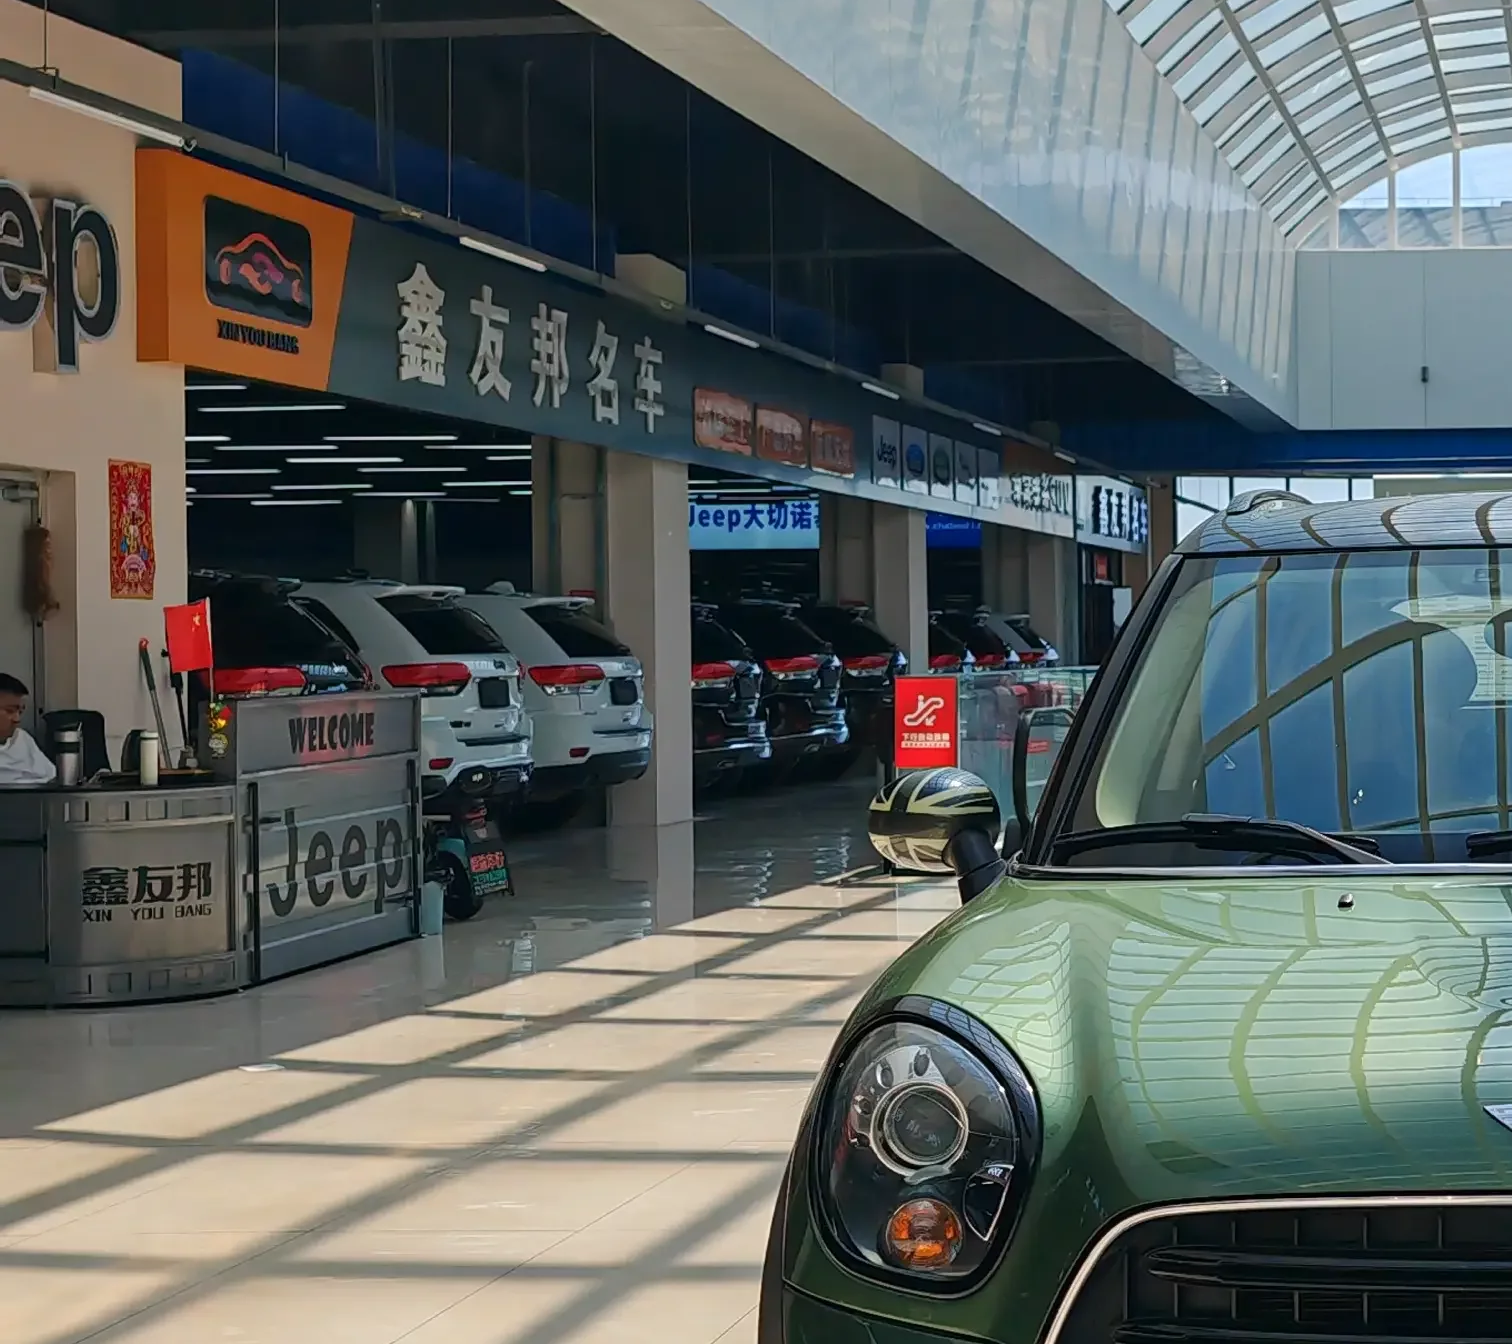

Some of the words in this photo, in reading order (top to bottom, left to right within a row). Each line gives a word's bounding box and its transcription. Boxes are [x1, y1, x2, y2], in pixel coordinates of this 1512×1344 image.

[397, 262, 664, 434] 鑫友邦名车
[288, 712, 375, 754] WELCOME
[81, 861, 212, 905] 鑫友邦
[265, 808, 403, 917] Jeep
[82, 909, 112, 922] XIN
[131, 906, 164, 921] YOU
[175, 903, 212, 918] BANG
